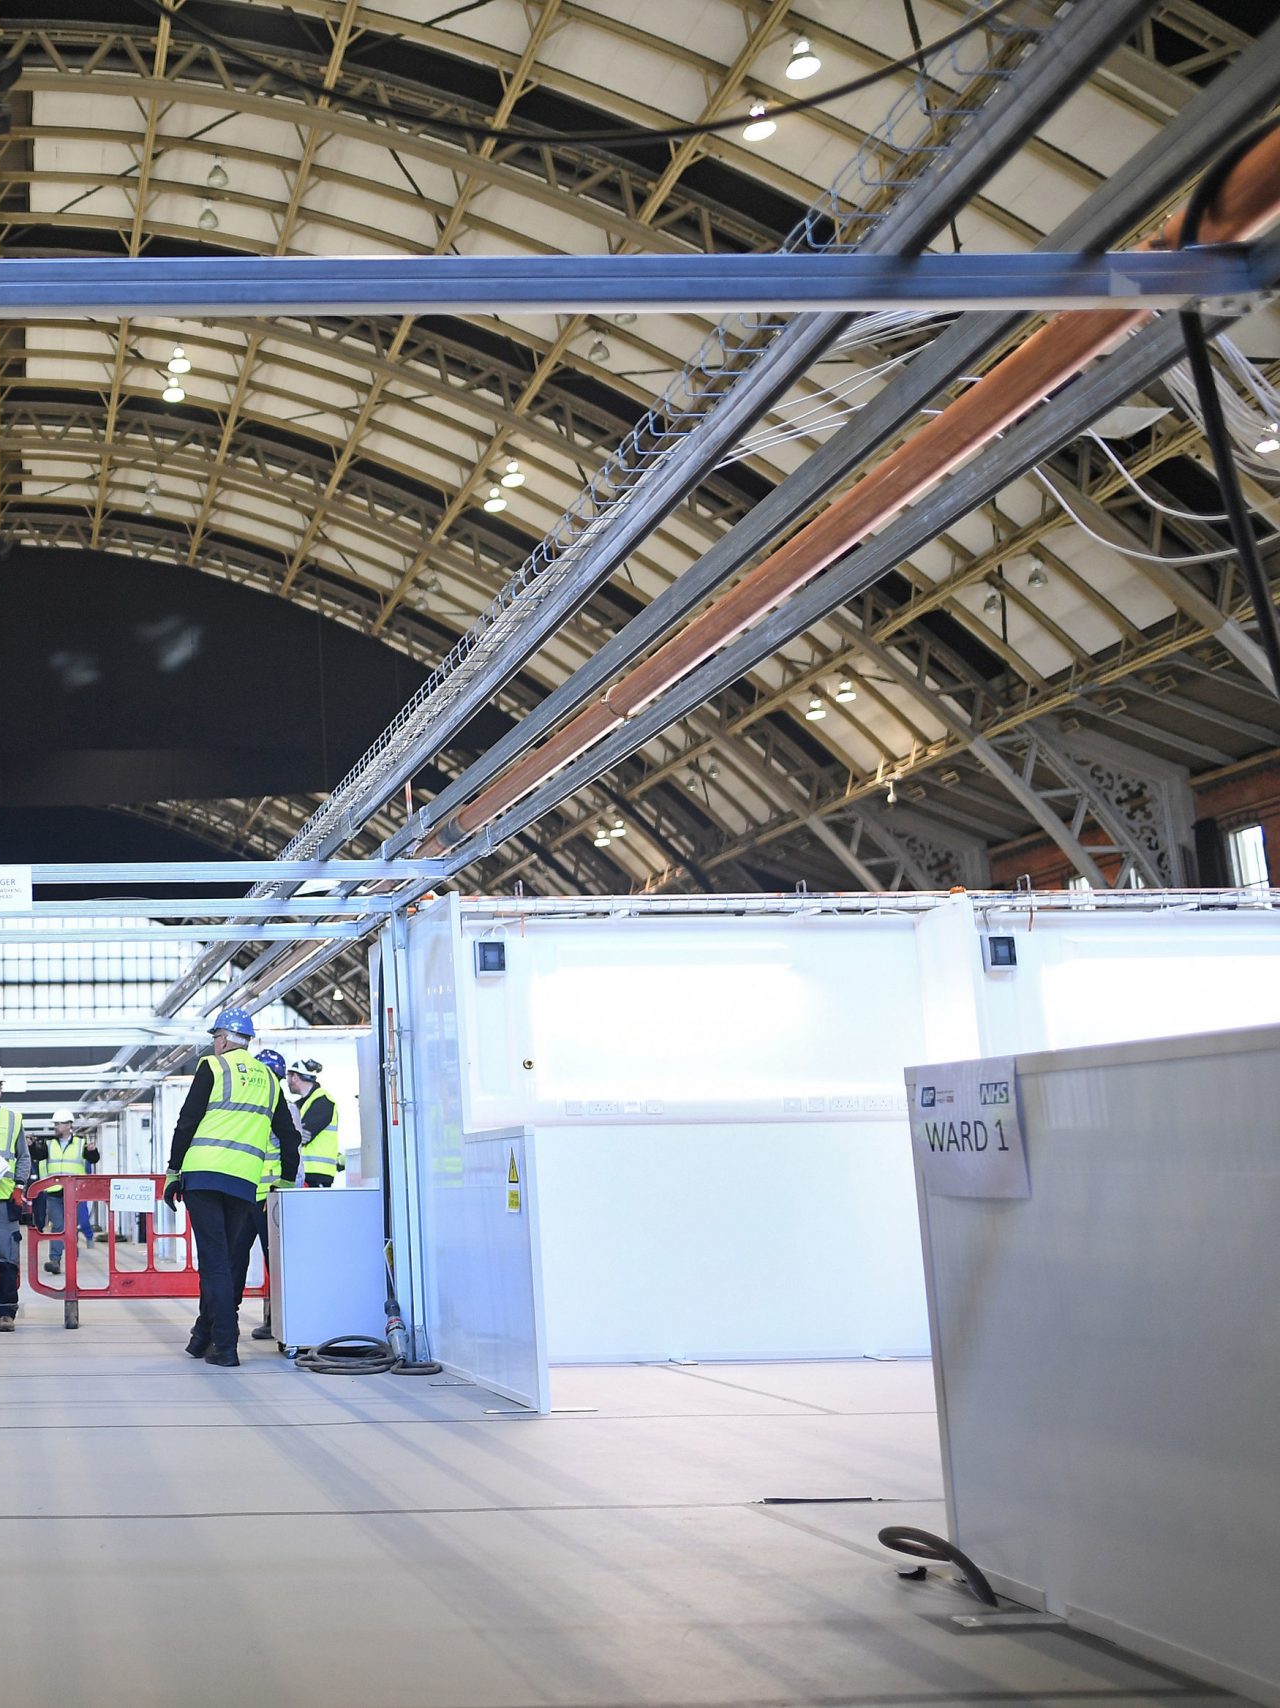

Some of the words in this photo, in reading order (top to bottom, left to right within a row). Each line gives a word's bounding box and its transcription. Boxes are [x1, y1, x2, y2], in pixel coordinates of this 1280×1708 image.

[980, 1082, 1009, 1105] NHS
[925, 1120, 988, 1152] WARD
[995, 1119, 1009, 1151] 1
[126, 1193, 151, 1201] ACCESS
